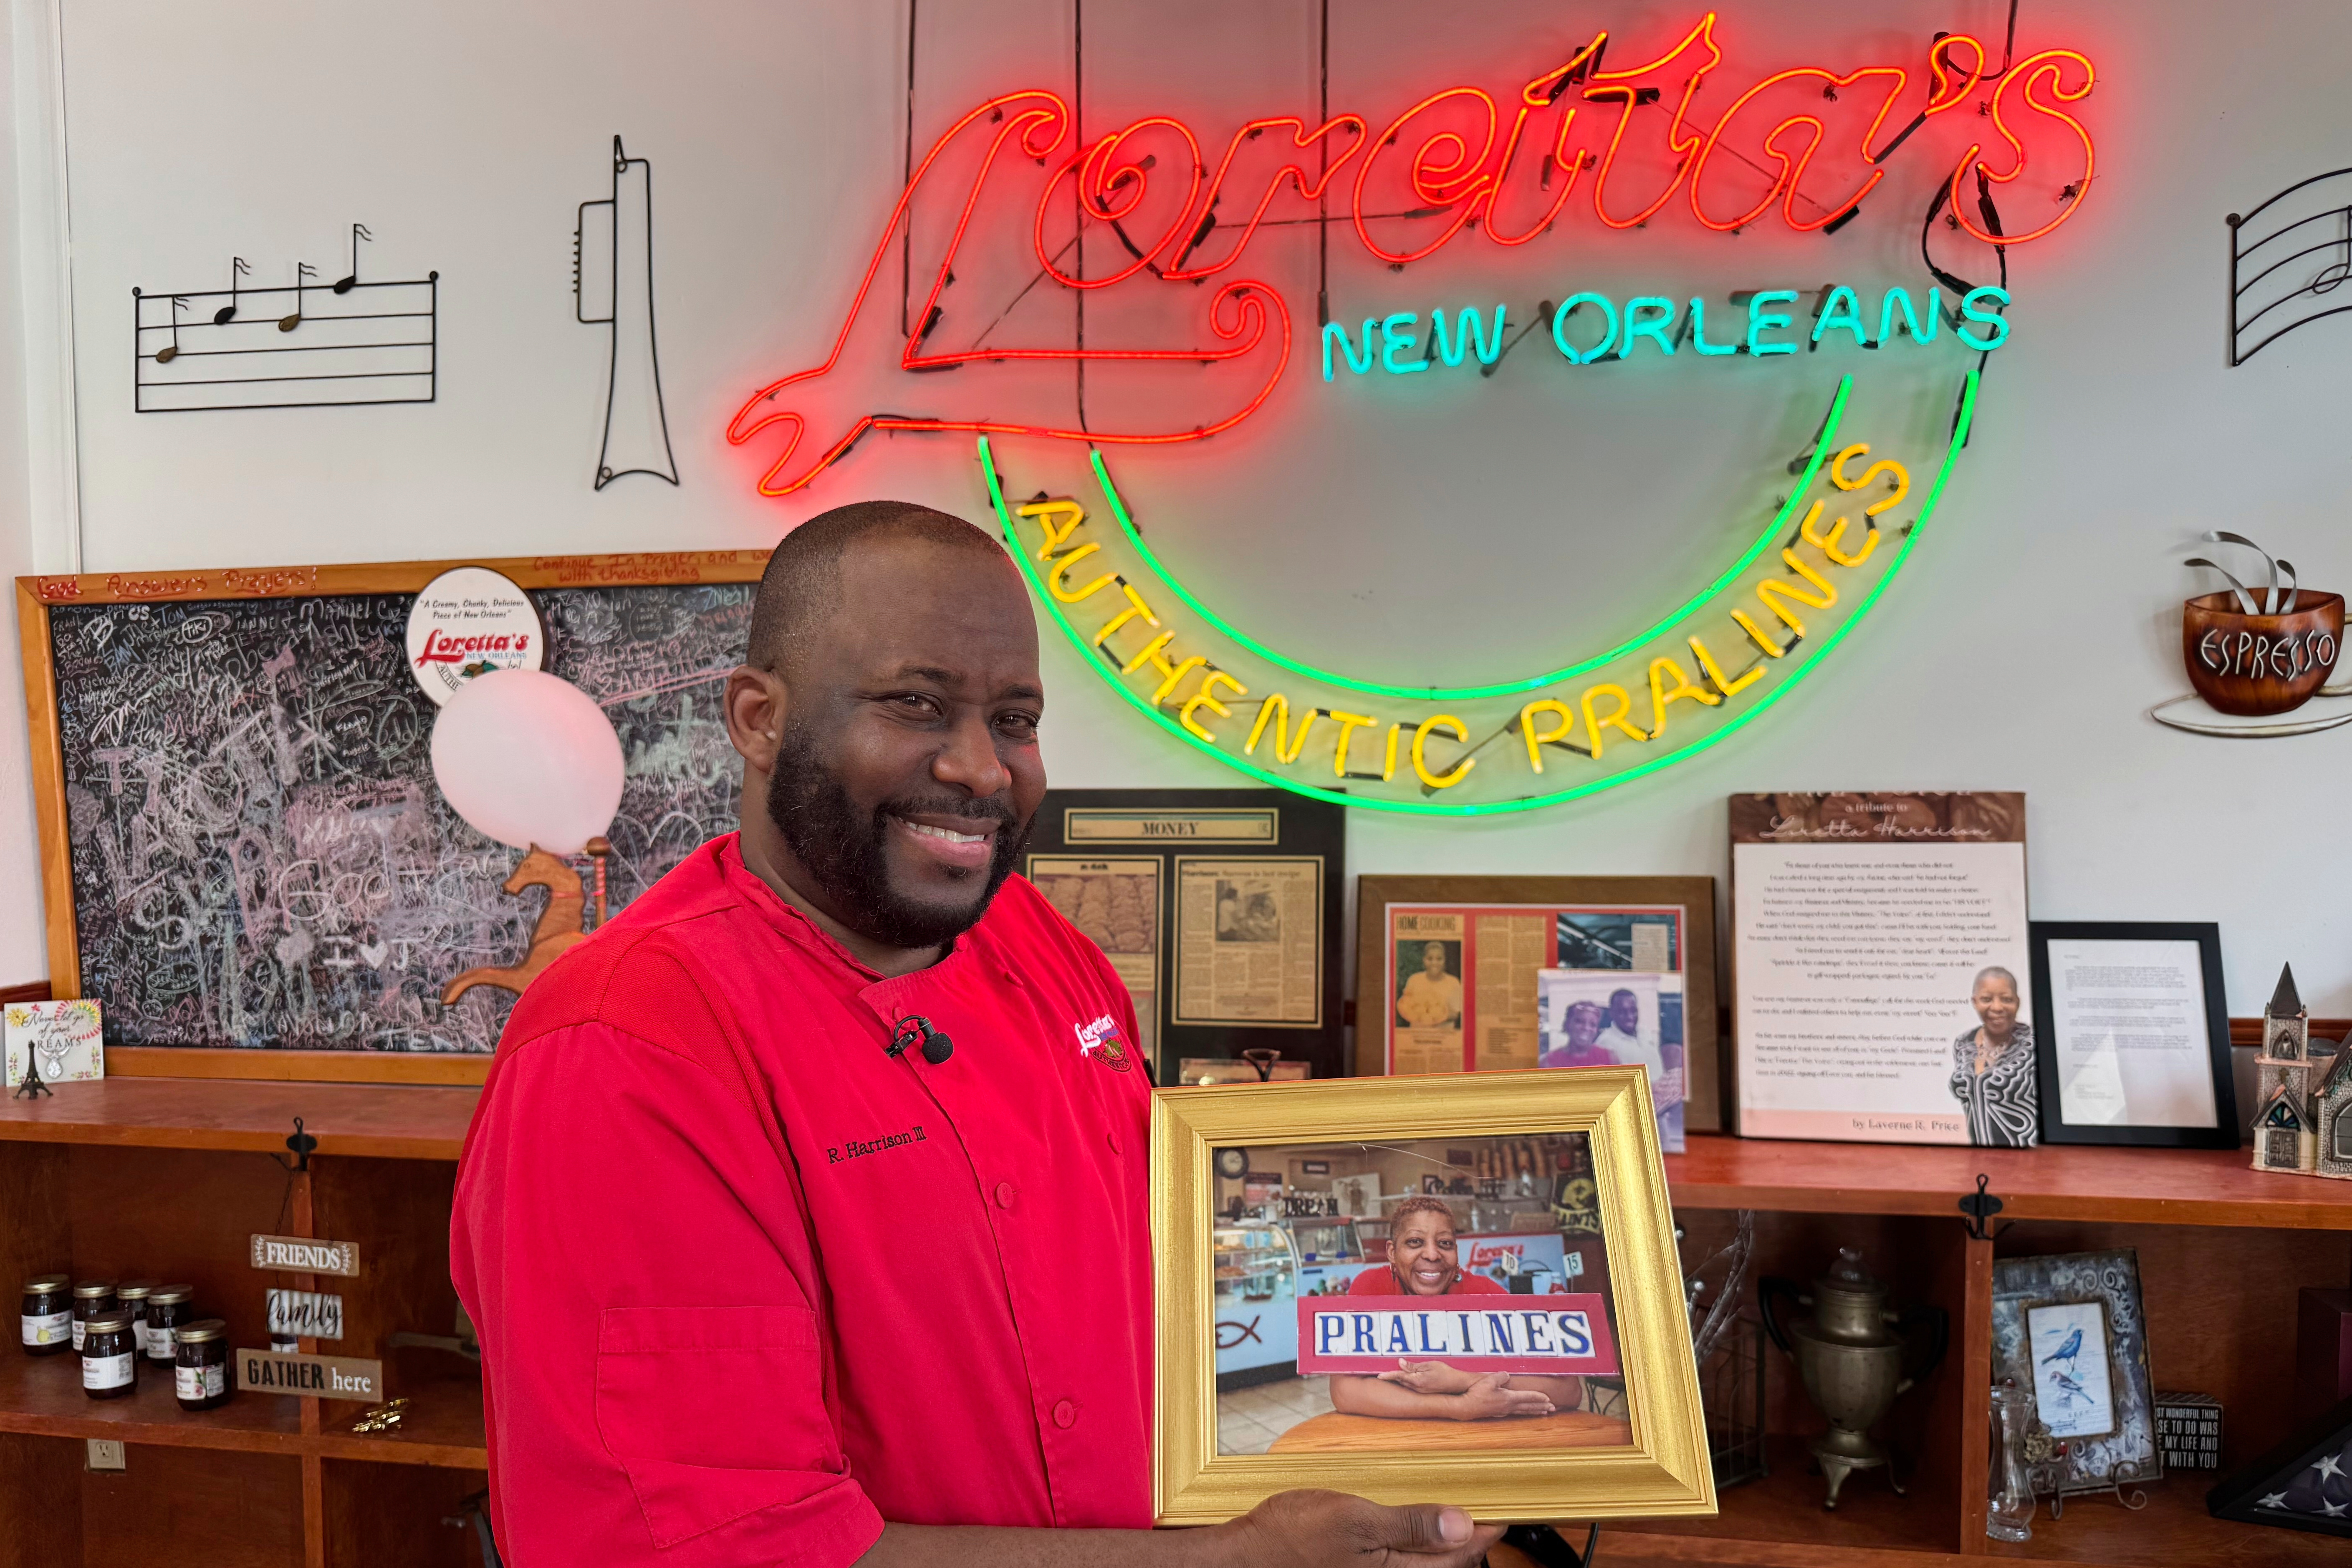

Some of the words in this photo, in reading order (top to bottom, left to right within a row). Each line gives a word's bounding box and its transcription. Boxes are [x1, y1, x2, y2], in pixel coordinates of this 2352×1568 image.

[725, 10, 2096, 496] Loretta's
[1324, 303, 1508, 381] NEW
[1552, 285, 2013, 366] ORLEANS
[534, 557, 599, 571] Continue
[559, 570, 592, 582] with
[37, 574, 82, 599] God
[106, 574, 207, 595] Answers
[432, 600, 460, 609] Creamy,
[493, 598, 524, 607] Delicious
[1015, 500, 1476, 789] AUTHENTIC
[1519, 442, 1910, 774] PRALINES
[414, 627, 530, 668] Loretta's
[466, 651, 485, 660] NEW
[488, 651, 527, 659] ORLEANS
[2201, 628, 2335, 682] ESPRESSO
[1855, 803, 1893, 813] tribute
[1896, 803, 1909, 813] to
[1142, 821, 1199, 835] MONEY
[1759, 815, 1869, 839] Loretta
[1873, 815, 1992, 838] Harrison
[1397, 916, 1417, 931] HOME
[1420, 916, 1456, 931] COOKING
[37, 1038, 82, 1050] REAMS
[1852, 1119, 1864, 1131] by
[1868, 1119, 1913, 1131] Laverne
[1931, 1120, 1960, 1131] Price
[826, 1148, 845, 1164] R.
[845, 1132, 913, 1159] Harrison
[912, 1125, 927, 1141] III
[266, 1241, 341, 1270] FRIENDS
[1566, 1255, 1579, 1272] 15
[1317, 1312, 1590, 1355] PRALINES
[248, 1358, 325, 1390] GATHER
[331, 1366, 371, 1393] here
[2165, 1407, 2200, 1419] WONDERFUL
[2201, 1409, 2219, 1420] THING
[2171, 1419, 2182, 1434] TO
[2185, 1420, 2196, 1435] DO
[2199, 1421, 2218, 1436] WAS
[2165, 1435, 2178, 1449] MY
[2181, 1436, 2198, 1450] LIFE
[2200, 1437, 2218, 1451] AND
[2169, 1450, 2194, 1467] WITH
[2198, 1452, 2217, 1469] YOU
